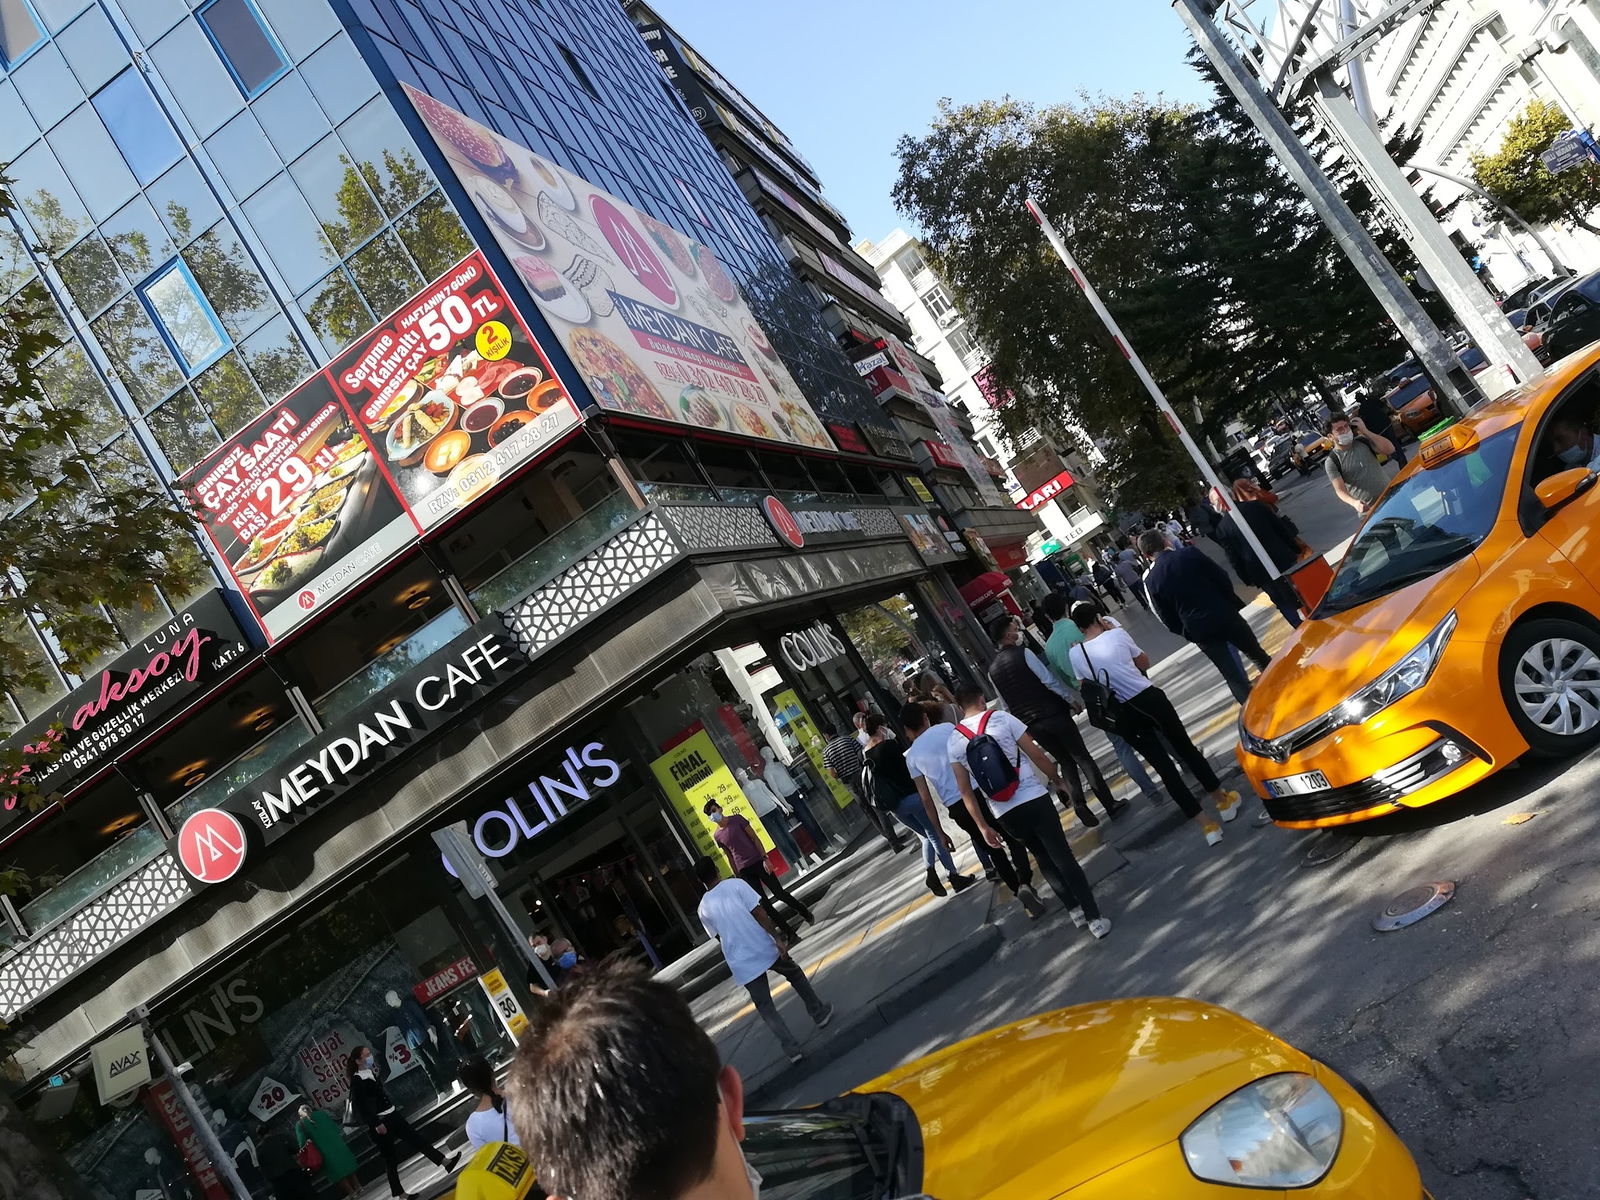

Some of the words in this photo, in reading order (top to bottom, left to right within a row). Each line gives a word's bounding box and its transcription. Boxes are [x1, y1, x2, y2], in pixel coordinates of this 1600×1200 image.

[401, 288, 446, 330] HAFTANIN
[443, 287, 452, 298] 7
[451, 265, 477, 290] GÜNÜ
[368, 330, 421, 389] Kahvaltı
[418, 295, 473, 351] 50
[472, 295, 498, 319] TL
[482, 325, 497, 344] 2
[486, 337, 510, 358] KİŞİLİK
[619, 297, 706, 350] MEYDAN
[700, 329, 744, 364] CAFE
[345, 333, 392, 389] Serpme
[366, 371, 409, 419] SINIRSIZ
[405, 342, 428, 373] ÇAY
[196, 446, 244, 496] SINIRSIZ
[203, 468, 239, 510] ÇAY
[240, 410, 297, 471] SAATİ
[218, 502, 240, 523] 12:00
[242, 480, 263, 501] 17:00
[261, 441, 298, 480] SAATLERİ
[297, 404, 337, 445] ARASINDA
[226, 478, 252, 503] HAFTA
[249, 466, 263, 481] İÇİ
[259, 437, 292, 470] HERGÜN
[429, 487, 460, 515] RZV:
[459, 460, 497, 493] 0312
[495, 442, 522, 468] 417
[522, 428, 542, 448] 28
[541, 412, 560, 433] 27
[233, 502, 259, 529] KİŞİ
[256, 457, 313, 518] 29
[240, 512, 269, 541] BAŞI
[316, 561, 357, 596] MEYDAN
[356, 543, 382, 566] CAFE
[143, 612, 194, 654] LUNA
[211, 648, 239, 671] KAT:
[237, 642, 245, 653] 6
[780, 618, 847, 673] COLIN'S
[72, 627, 211, 731] aksoy
[79, 735, 93, 752] VE
[92, 704, 143, 743] GÜZELLİK
[141, 668, 185, 707] MERKEZİ
[262, 699, 413, 823] MEYDAN
[415, 632, 509, 712] CAFE
[73, 747, 99, 770] 0541
[99, 733, 119, 752] 878
[118, 724, 133, 739] 30
[132, 712, 146, 729] 17
[669, 750, 707, 782] FİNAL
[679, 763, 714, 793] İNDİRİMİ
[1284, 780, 1295, 793] T
[426, 967, 458, 998] JEANS
[499, 997, 518, 1019] 30
[109, 1050, 142, 1078] AVAX
[301, 1029, 344, 1071] Hayat
